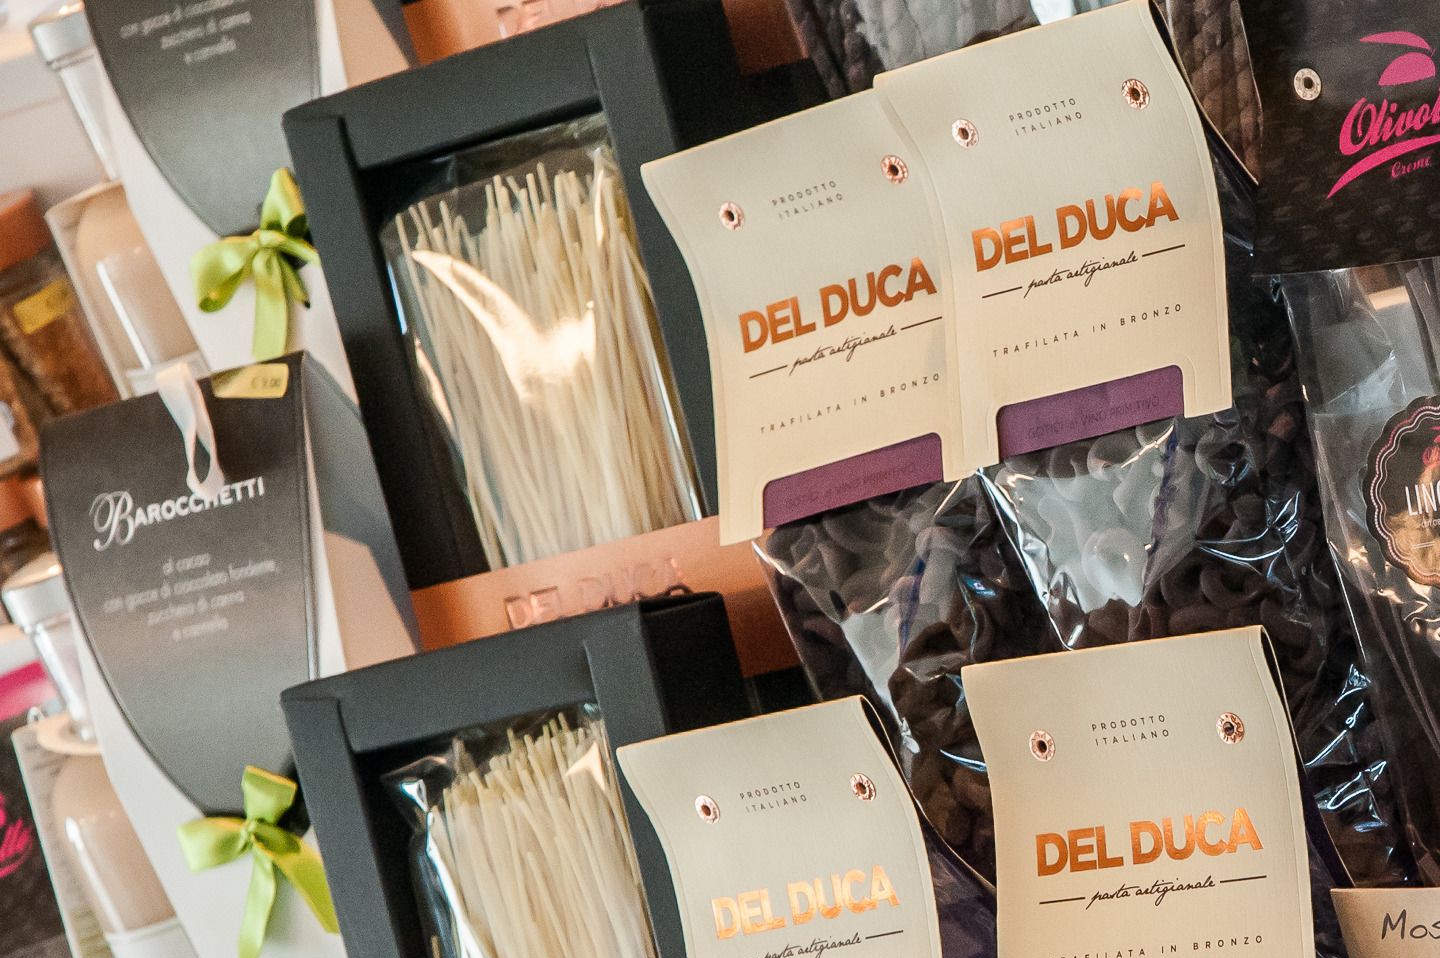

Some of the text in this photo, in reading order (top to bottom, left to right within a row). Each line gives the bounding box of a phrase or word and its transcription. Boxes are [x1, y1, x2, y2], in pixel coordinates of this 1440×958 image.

[1009, 98, 1077, 122] PRODOTTO
[1015, 112, 1082, 136] ITALIANO
[772, 180, 837, 206] PRODOTTO
[778, 192, 843, 220] ITALIANO
[972, 180, 1180, 272] DEL DUCA
[1024, 250, 1138, 298] pasta artigianale
[738, 256, 937, 353] DEL DUCA
[993, 304, 1181, 357] TRAFILATA IN BRONZO
[789, 324, 898, 376] pasta artigianale
[761, 373, 940, 434] TRAFILATA IN BRONZO
[1092, 714, 1166, 732] PRODOTTO
[1095, 729, 1170, 746] ITALIANO
[740, 781, 800, 800] PRODOTTO
[746, 794, 807, 813] ITALIANO
[1036, 807, 1264, 876] DEL DUCA
[711, 864, 901, 940] DEL DUCA
[1086, 875, 1215, 910] pasta artigianale
[1161, 944, 1177, 954] IN
[1193, 935, 1263, 950] BRONZO
